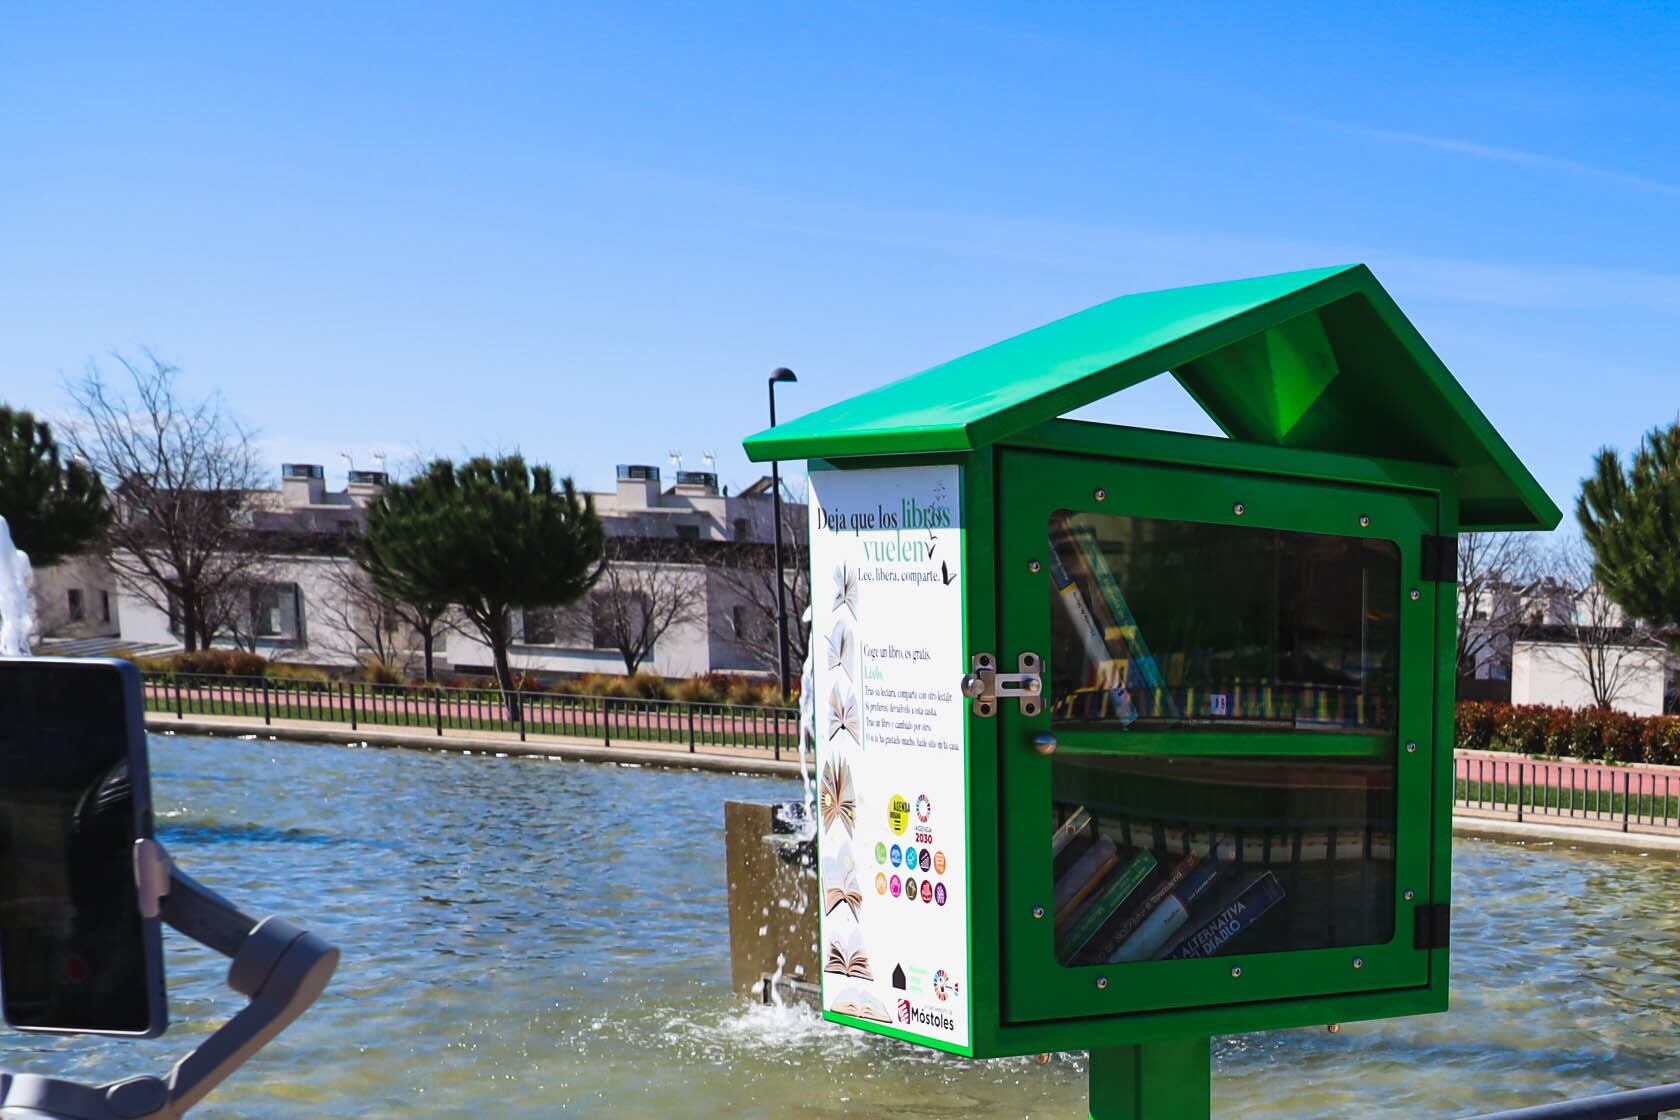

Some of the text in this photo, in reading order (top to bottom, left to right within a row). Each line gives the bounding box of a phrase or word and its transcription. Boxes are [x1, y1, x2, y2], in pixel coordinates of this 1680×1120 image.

[817, 497, 951, 537] Deja que los libros
[863, 529, 925, 563] vuelen
[901, 569, 941, 586] comparte.
[863, 644, 878, 661] Coge
[880, 648, 887, 658] un
[905, 650, 911, 659] es
[913, 648, 931, 663] gratis.
[893, 800, 911, 813] AGENDA
[915, 825, 932, 833] AGENDA
[915, 832, 933, 844] 2030
[1182, 899, 1247, 957] ALTERNATIVA
[1202, 919, 1241, 955] DIABLO
[911, 1006, 954, 1031] Móstoles
